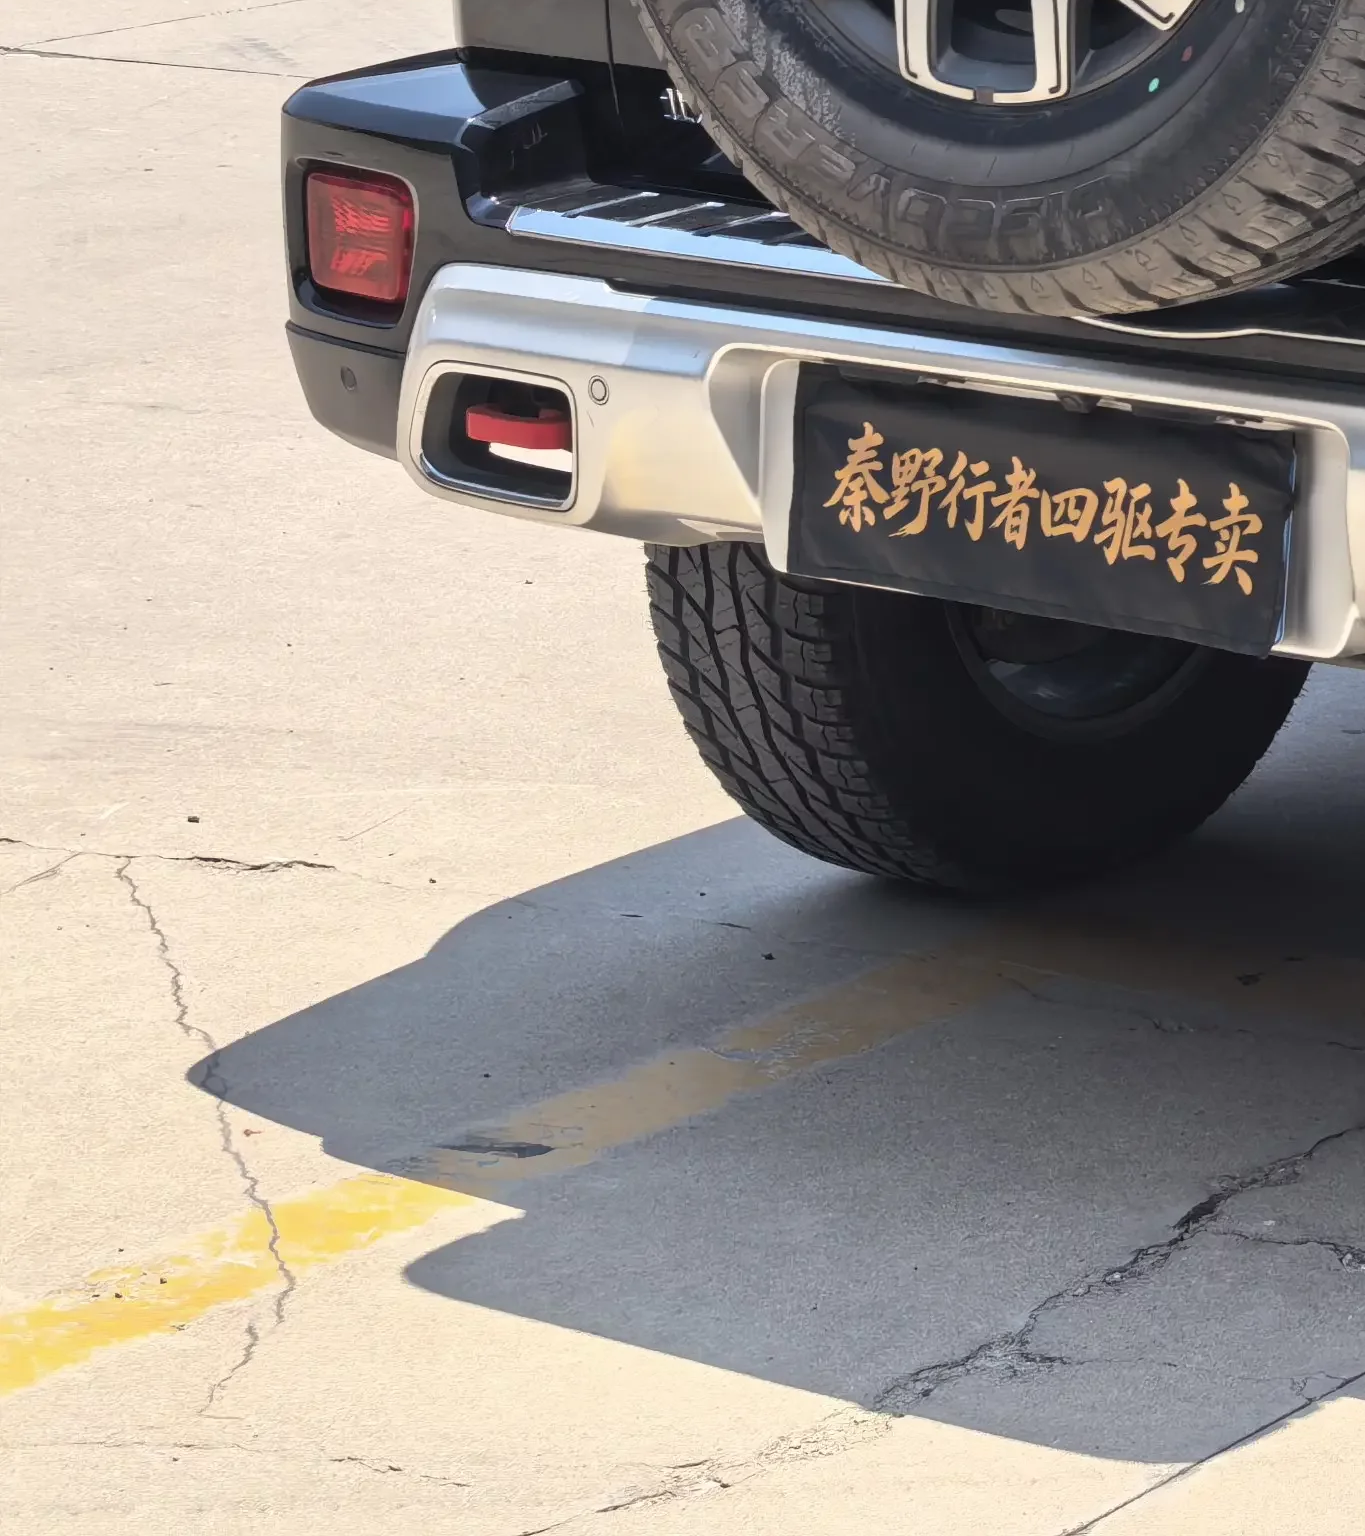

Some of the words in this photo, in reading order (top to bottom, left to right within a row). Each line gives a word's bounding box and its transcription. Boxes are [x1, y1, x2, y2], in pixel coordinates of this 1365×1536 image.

[823, 421, 1263, 595] 秦野行者四驱专卖
